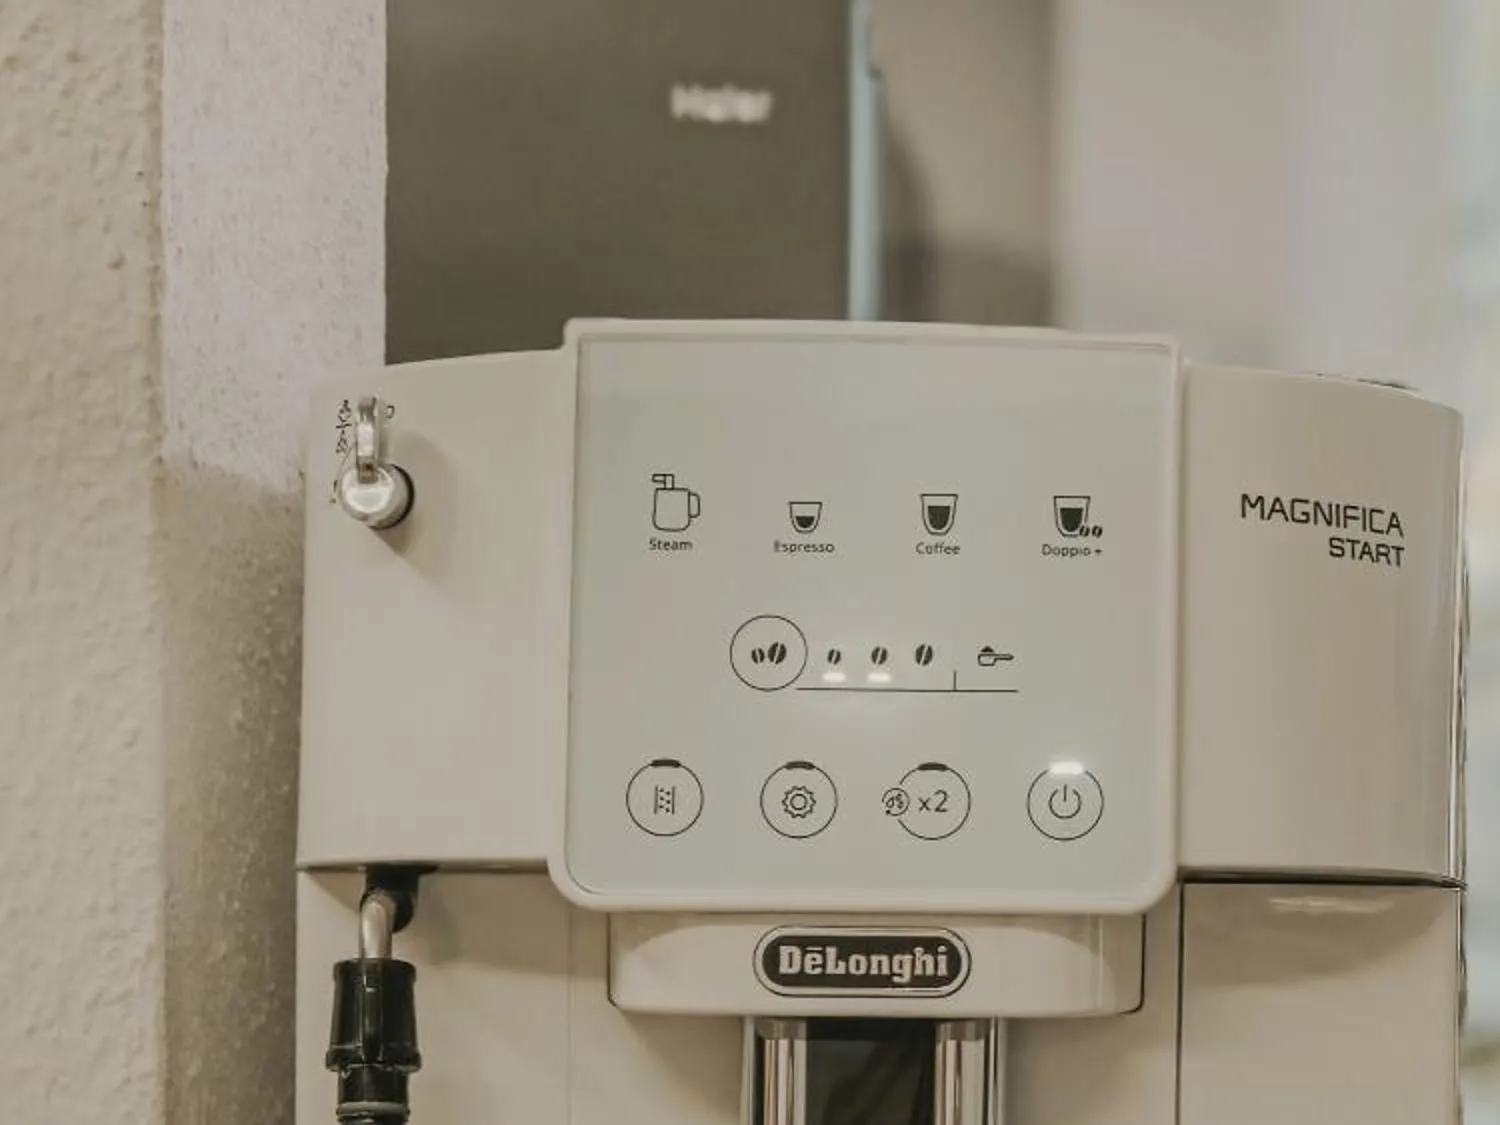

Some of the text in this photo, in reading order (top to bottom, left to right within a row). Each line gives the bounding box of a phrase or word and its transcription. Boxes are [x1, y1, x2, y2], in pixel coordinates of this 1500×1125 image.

[1240, 493, 1404, 538] MAGNIFICA
[649, 537, 693, 551] Steam
[774, 540, 836, 553] Espresso
[915, 541, 961, 555] Coffee
[1328, 537, 1405, 567] START
[918, 789, 949, 813] x2
